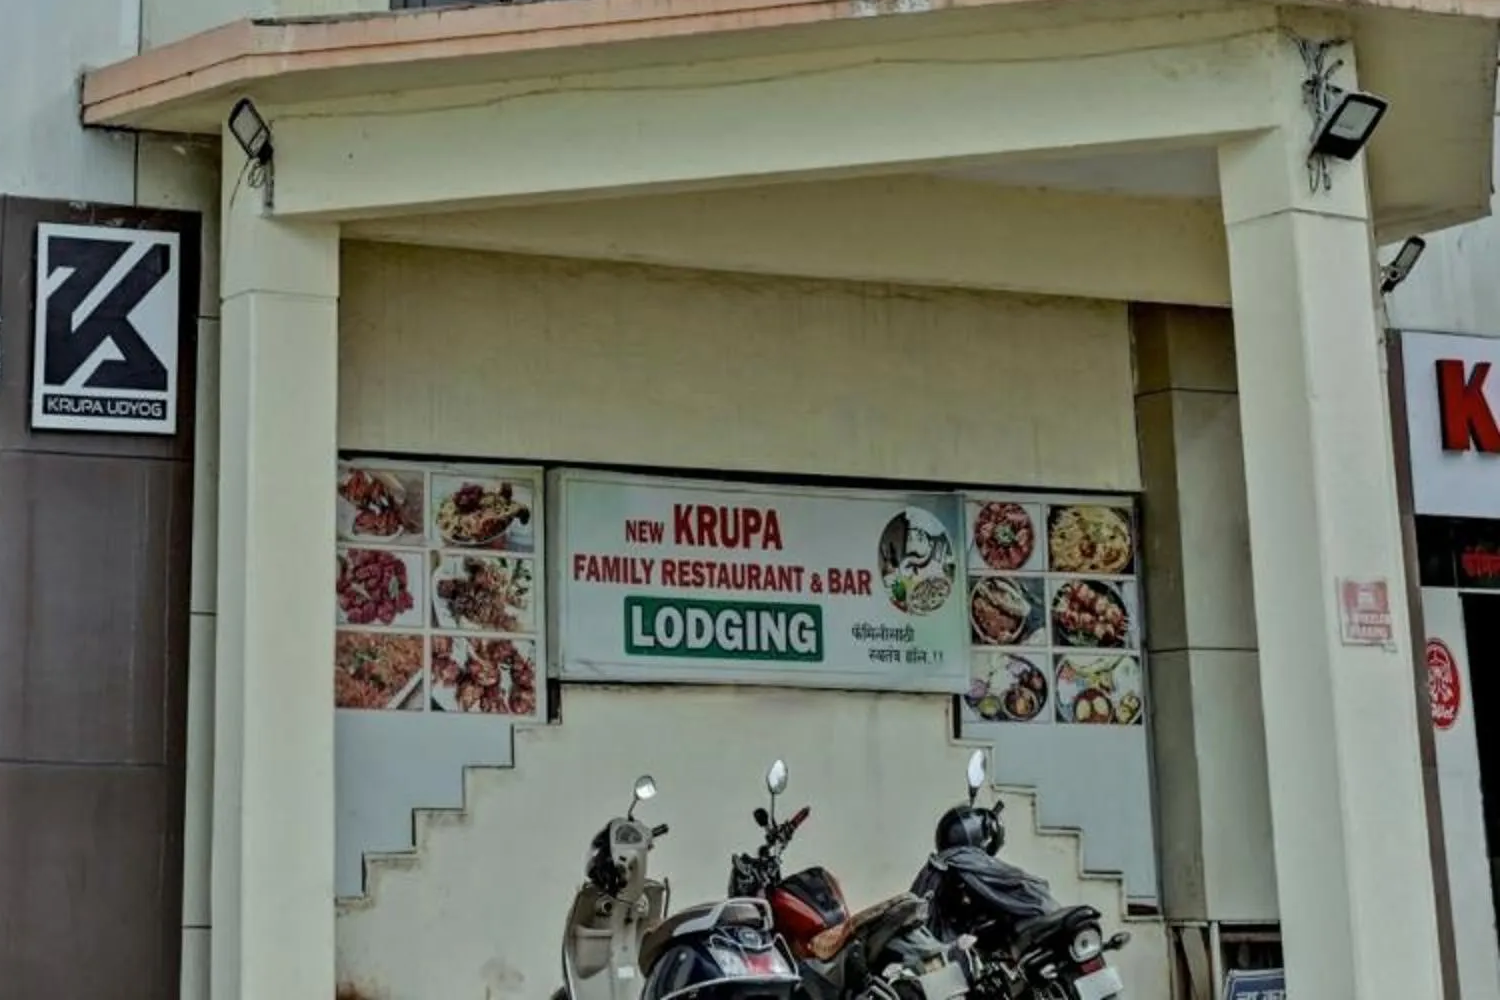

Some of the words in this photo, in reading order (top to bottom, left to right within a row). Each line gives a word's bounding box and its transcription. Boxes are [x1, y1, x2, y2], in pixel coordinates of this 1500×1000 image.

[47, 396, 104, 414] KRUPA
[107, 400, 163, 417] UDYOG
[1435, 359, 1500, 453] K
[625, 520, 663, 544] NEW
[673, 504, 783, 550] KRUPA
[573, 553, 653, 586] FAMILY
[661, 560, 804, 593] RESTAURANT
[811, 573, 823, 594] &
[827, 568, 872, 596] BAR
[631, 604, 817, 654] LODGING
